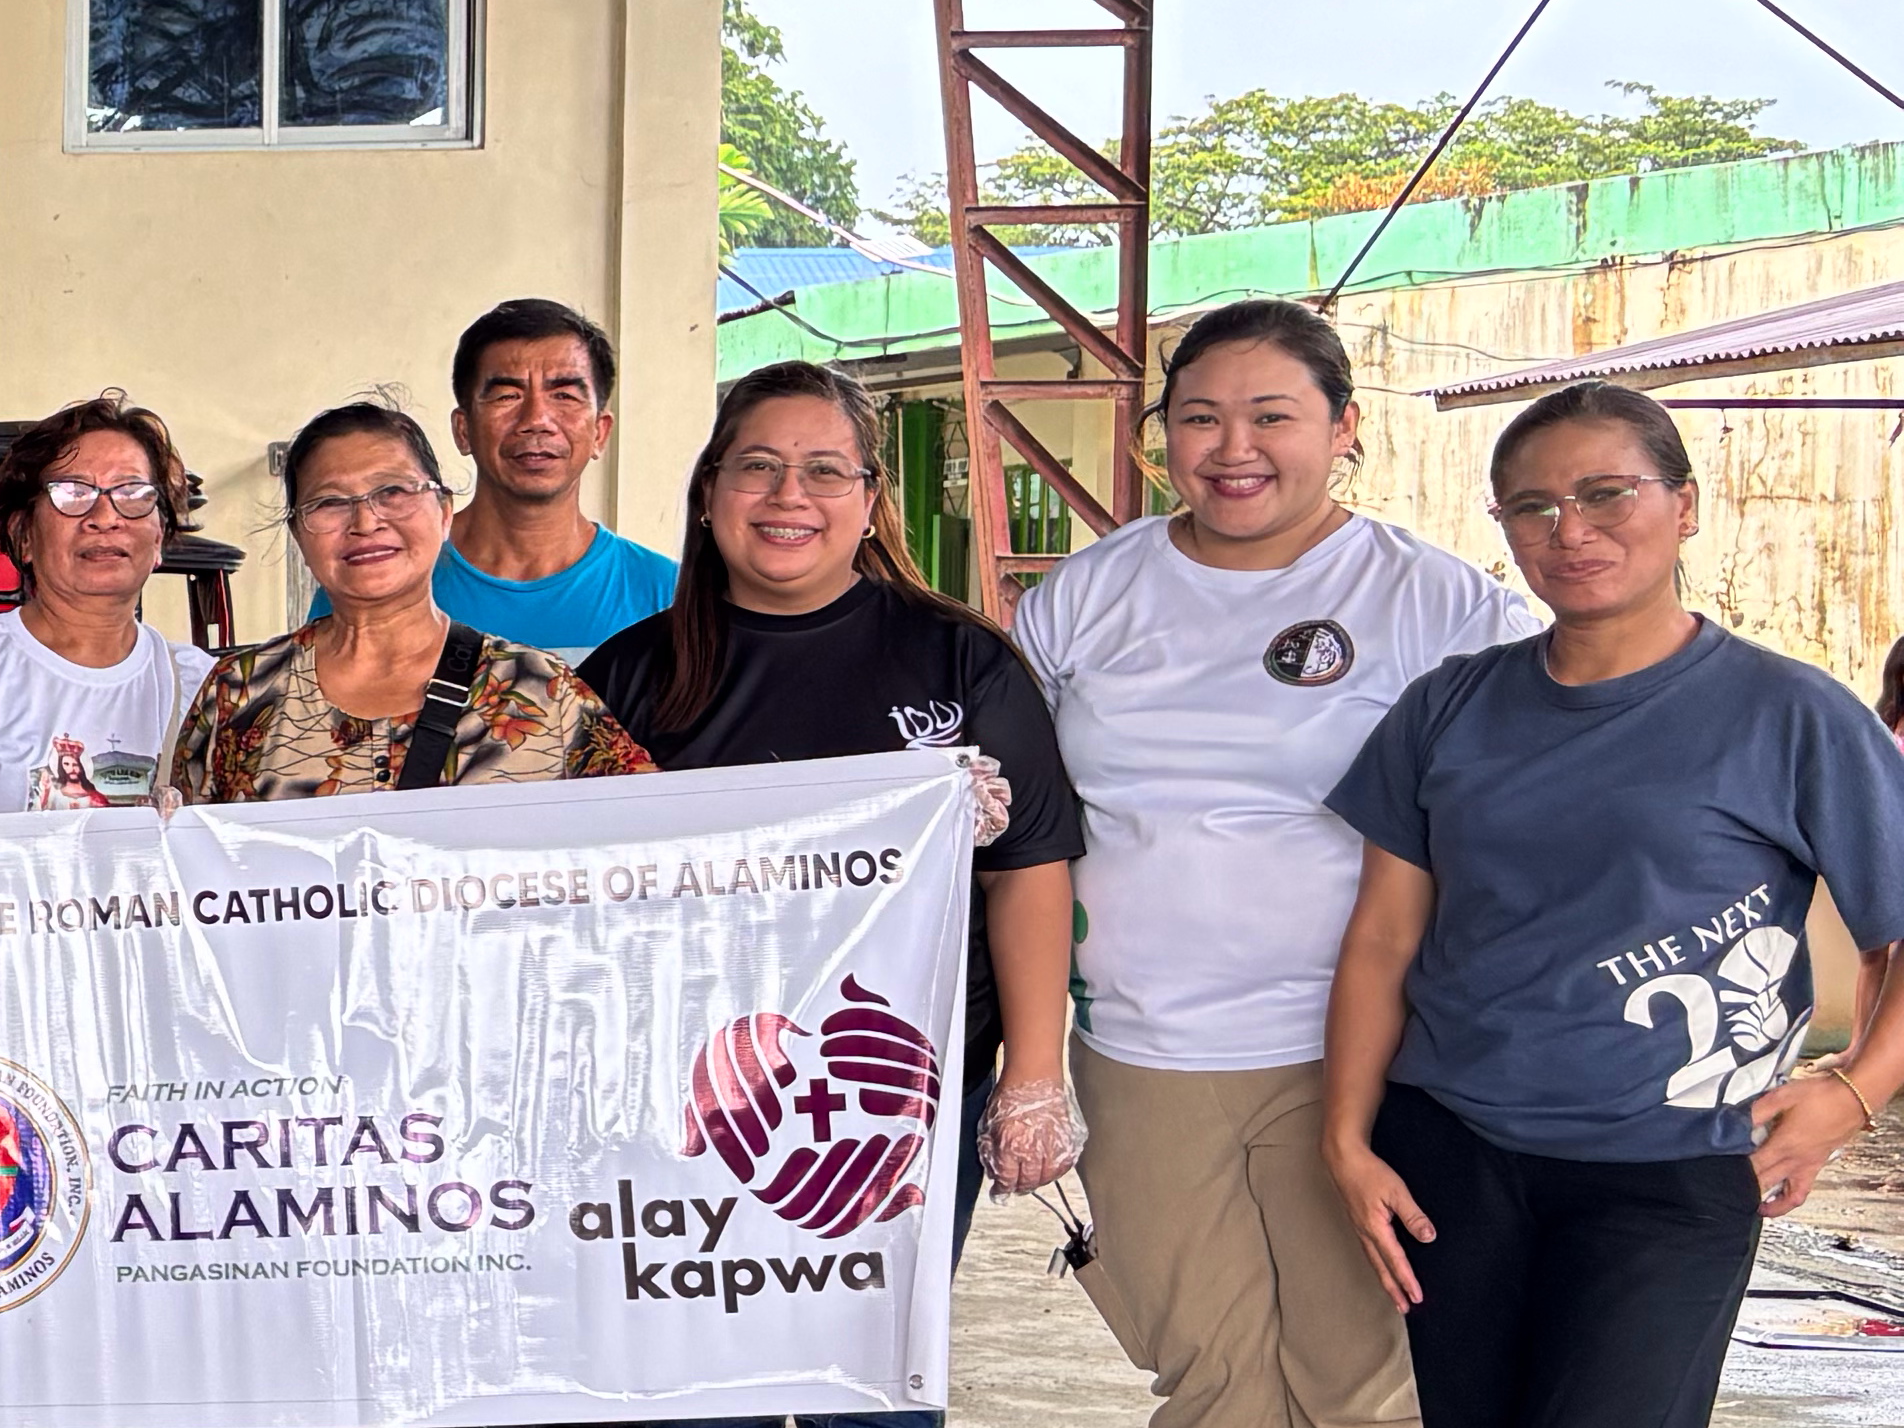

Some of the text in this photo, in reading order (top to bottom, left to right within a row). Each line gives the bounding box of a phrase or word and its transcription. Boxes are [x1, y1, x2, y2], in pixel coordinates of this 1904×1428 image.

[29, 891, 181, 934] ROMAN
[193, 880, 399, 925] CATHOLIC
[409, 869, 590, 915] DIOCESE
[602, 864, 658, 903] OF
[671, 847, 905, 898] ALAMINOS
[1597, 883, 1771, 985] THE NEXT
[106, 1074, 345, 1105] FAITH IN ACTION
[107, 1112, 445, 1174] CARITAS
[110, 1178, 536, 1243] ALAMINOS
[569, 1178, 739, 1253] alay
[116, 1253, 532, 1283] PANGASINAN FOUNDATION INC.
[622, 1242, 886, 1314] kapwa
